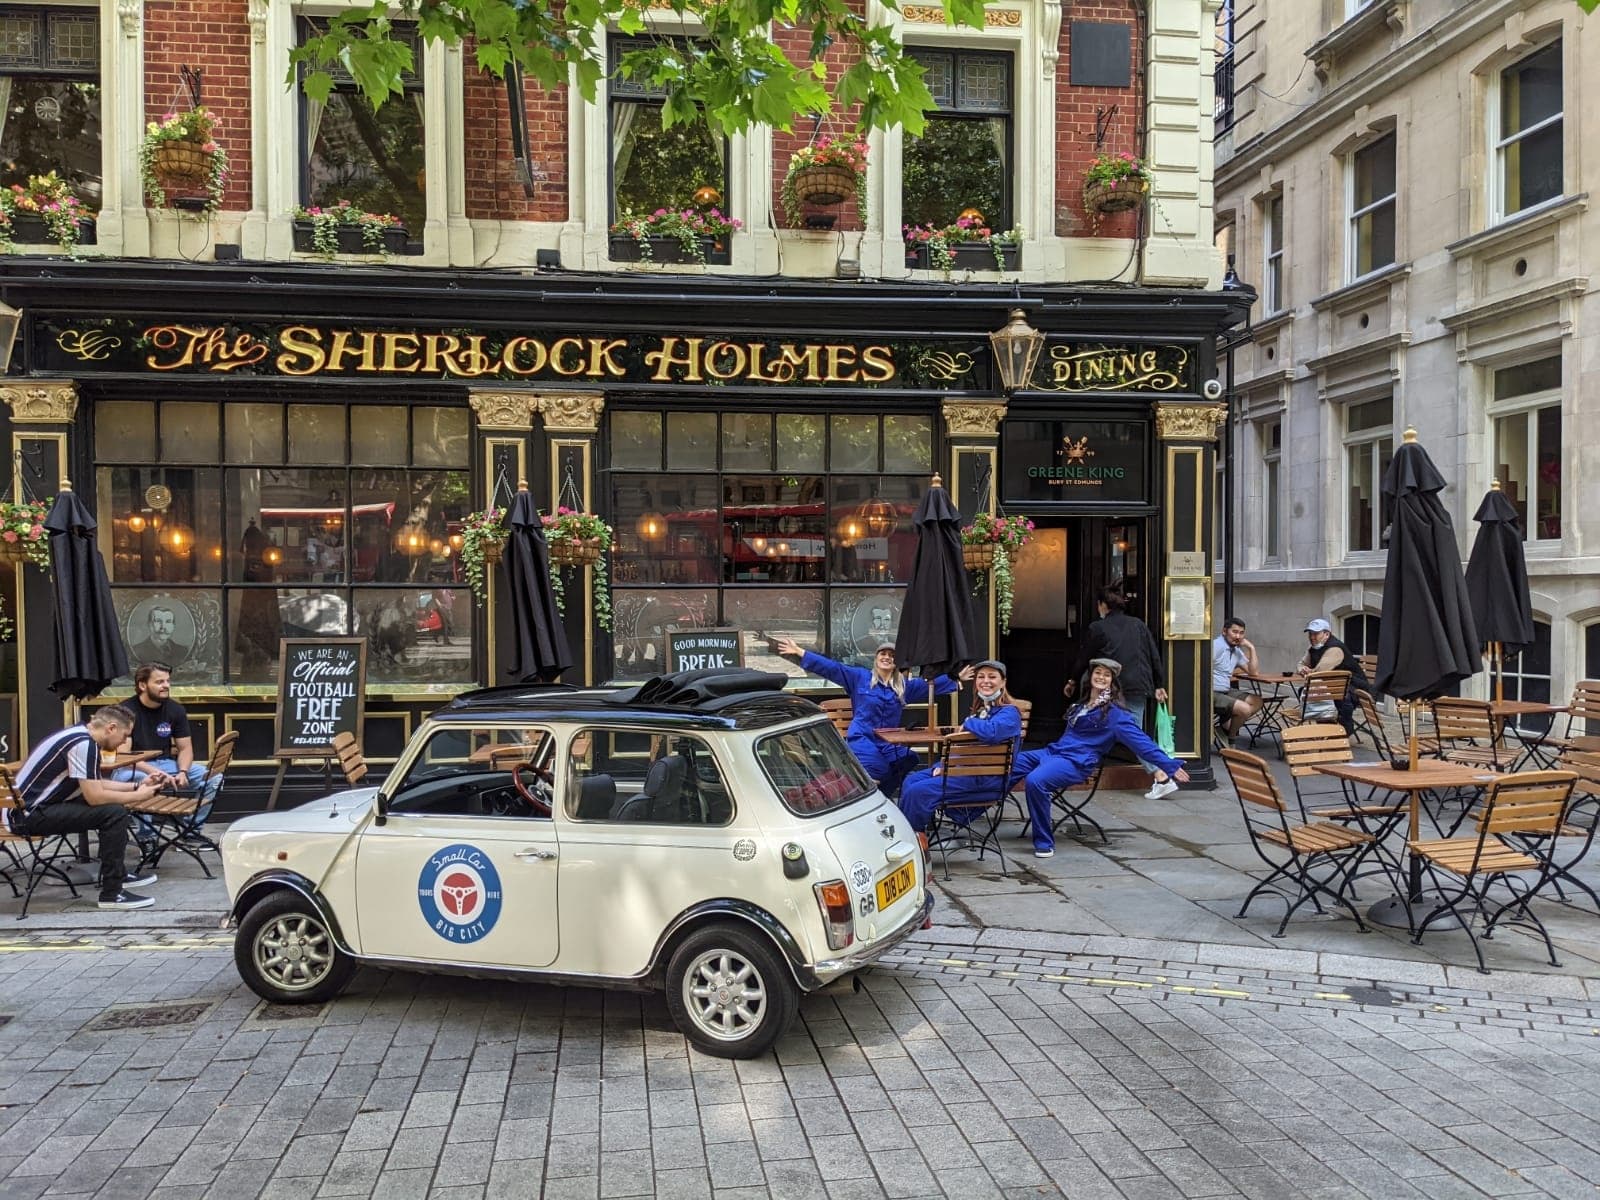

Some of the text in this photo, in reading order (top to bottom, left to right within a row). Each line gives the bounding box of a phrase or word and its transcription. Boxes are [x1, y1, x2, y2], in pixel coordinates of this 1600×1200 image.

[143, 326, 896, 382] The SHERLOCK HOLMES
[1053, 351, 1156, 382] DINING
[1027, 466, 1125, 478] GREENE KING
[298, 648, 349, 660] WE ARE AN
[674, 637, 737, 651] GOOD MORNING!
[292, 660, 356, 683] Official
[289, 682, 357, 697] FOOTBALL
[296, 698, 343, 720] FREE
[302, 721, 335, 735] ZONE
[431, 848, 486, 872] Small Car
[884, 866, 911, 903] D18 LDN
[860, 893, 875, 917] GB
[435, 919, 486, 940] BIG CITY
